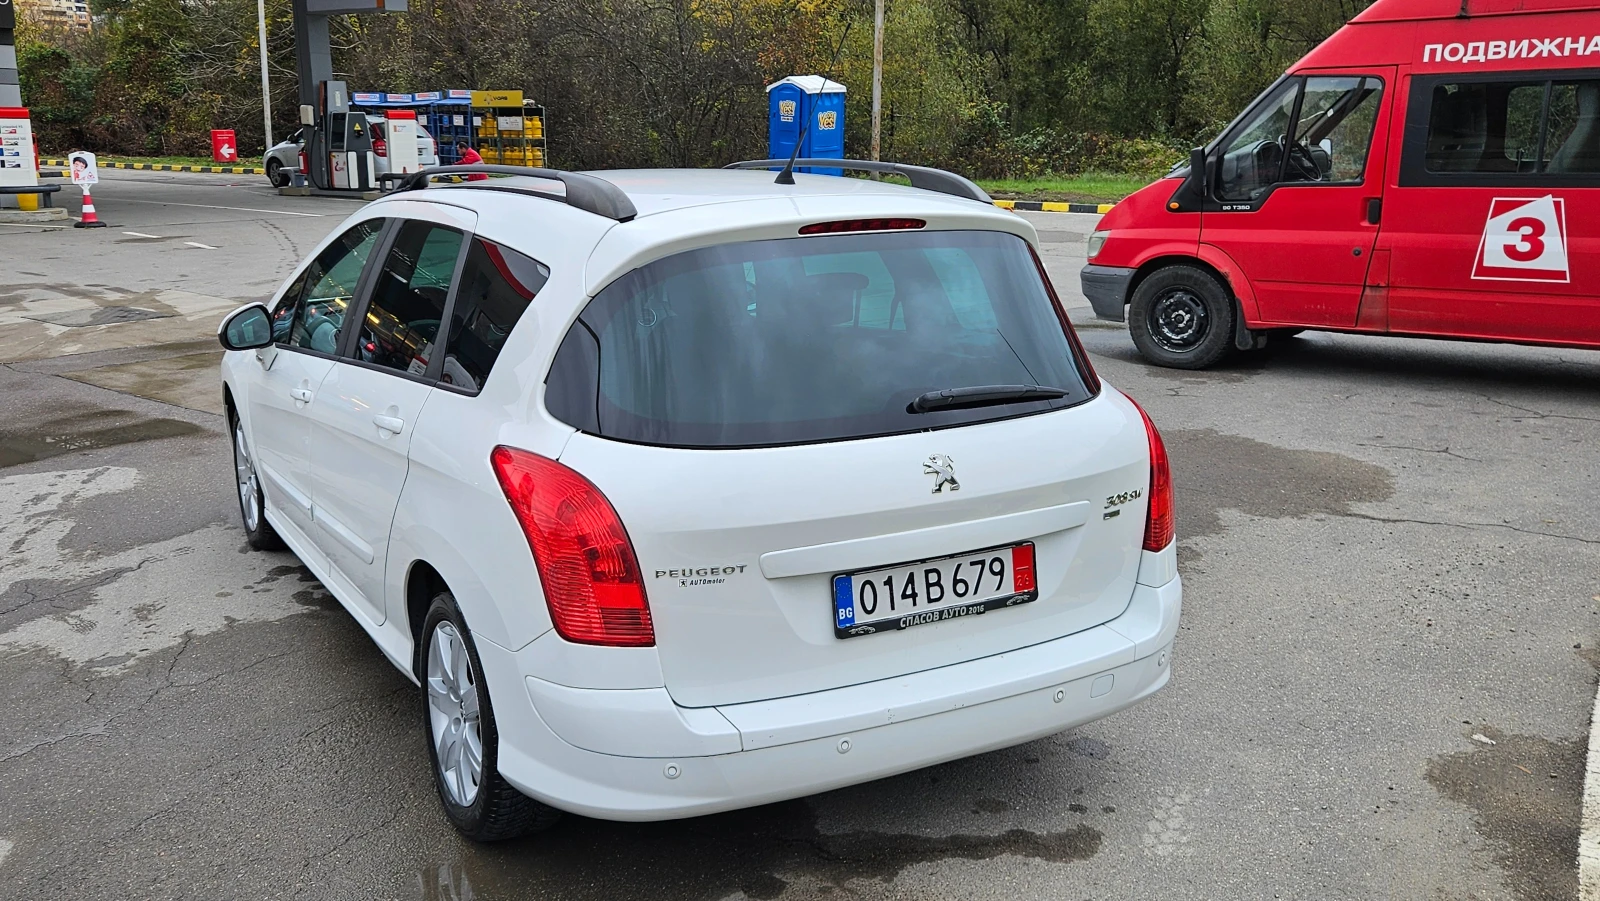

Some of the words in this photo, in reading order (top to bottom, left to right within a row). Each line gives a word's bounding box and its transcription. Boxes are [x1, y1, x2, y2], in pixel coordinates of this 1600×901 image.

[1422, 35, 1600, 63] ПОДВИЖНА
[1503, 216, 1546, 262] 3
[1104, 491, 1128, 509] 308
[655, 564, 747, 578] PEUGEOT
[859, 556, 1005, 615] 014B679
[838, 607, 853, 620] BG
[900, 611, 940, 628] СПАСОВ
[941, 606, 967, 620] АУТО
[968, 604, 985, 615] 2016
